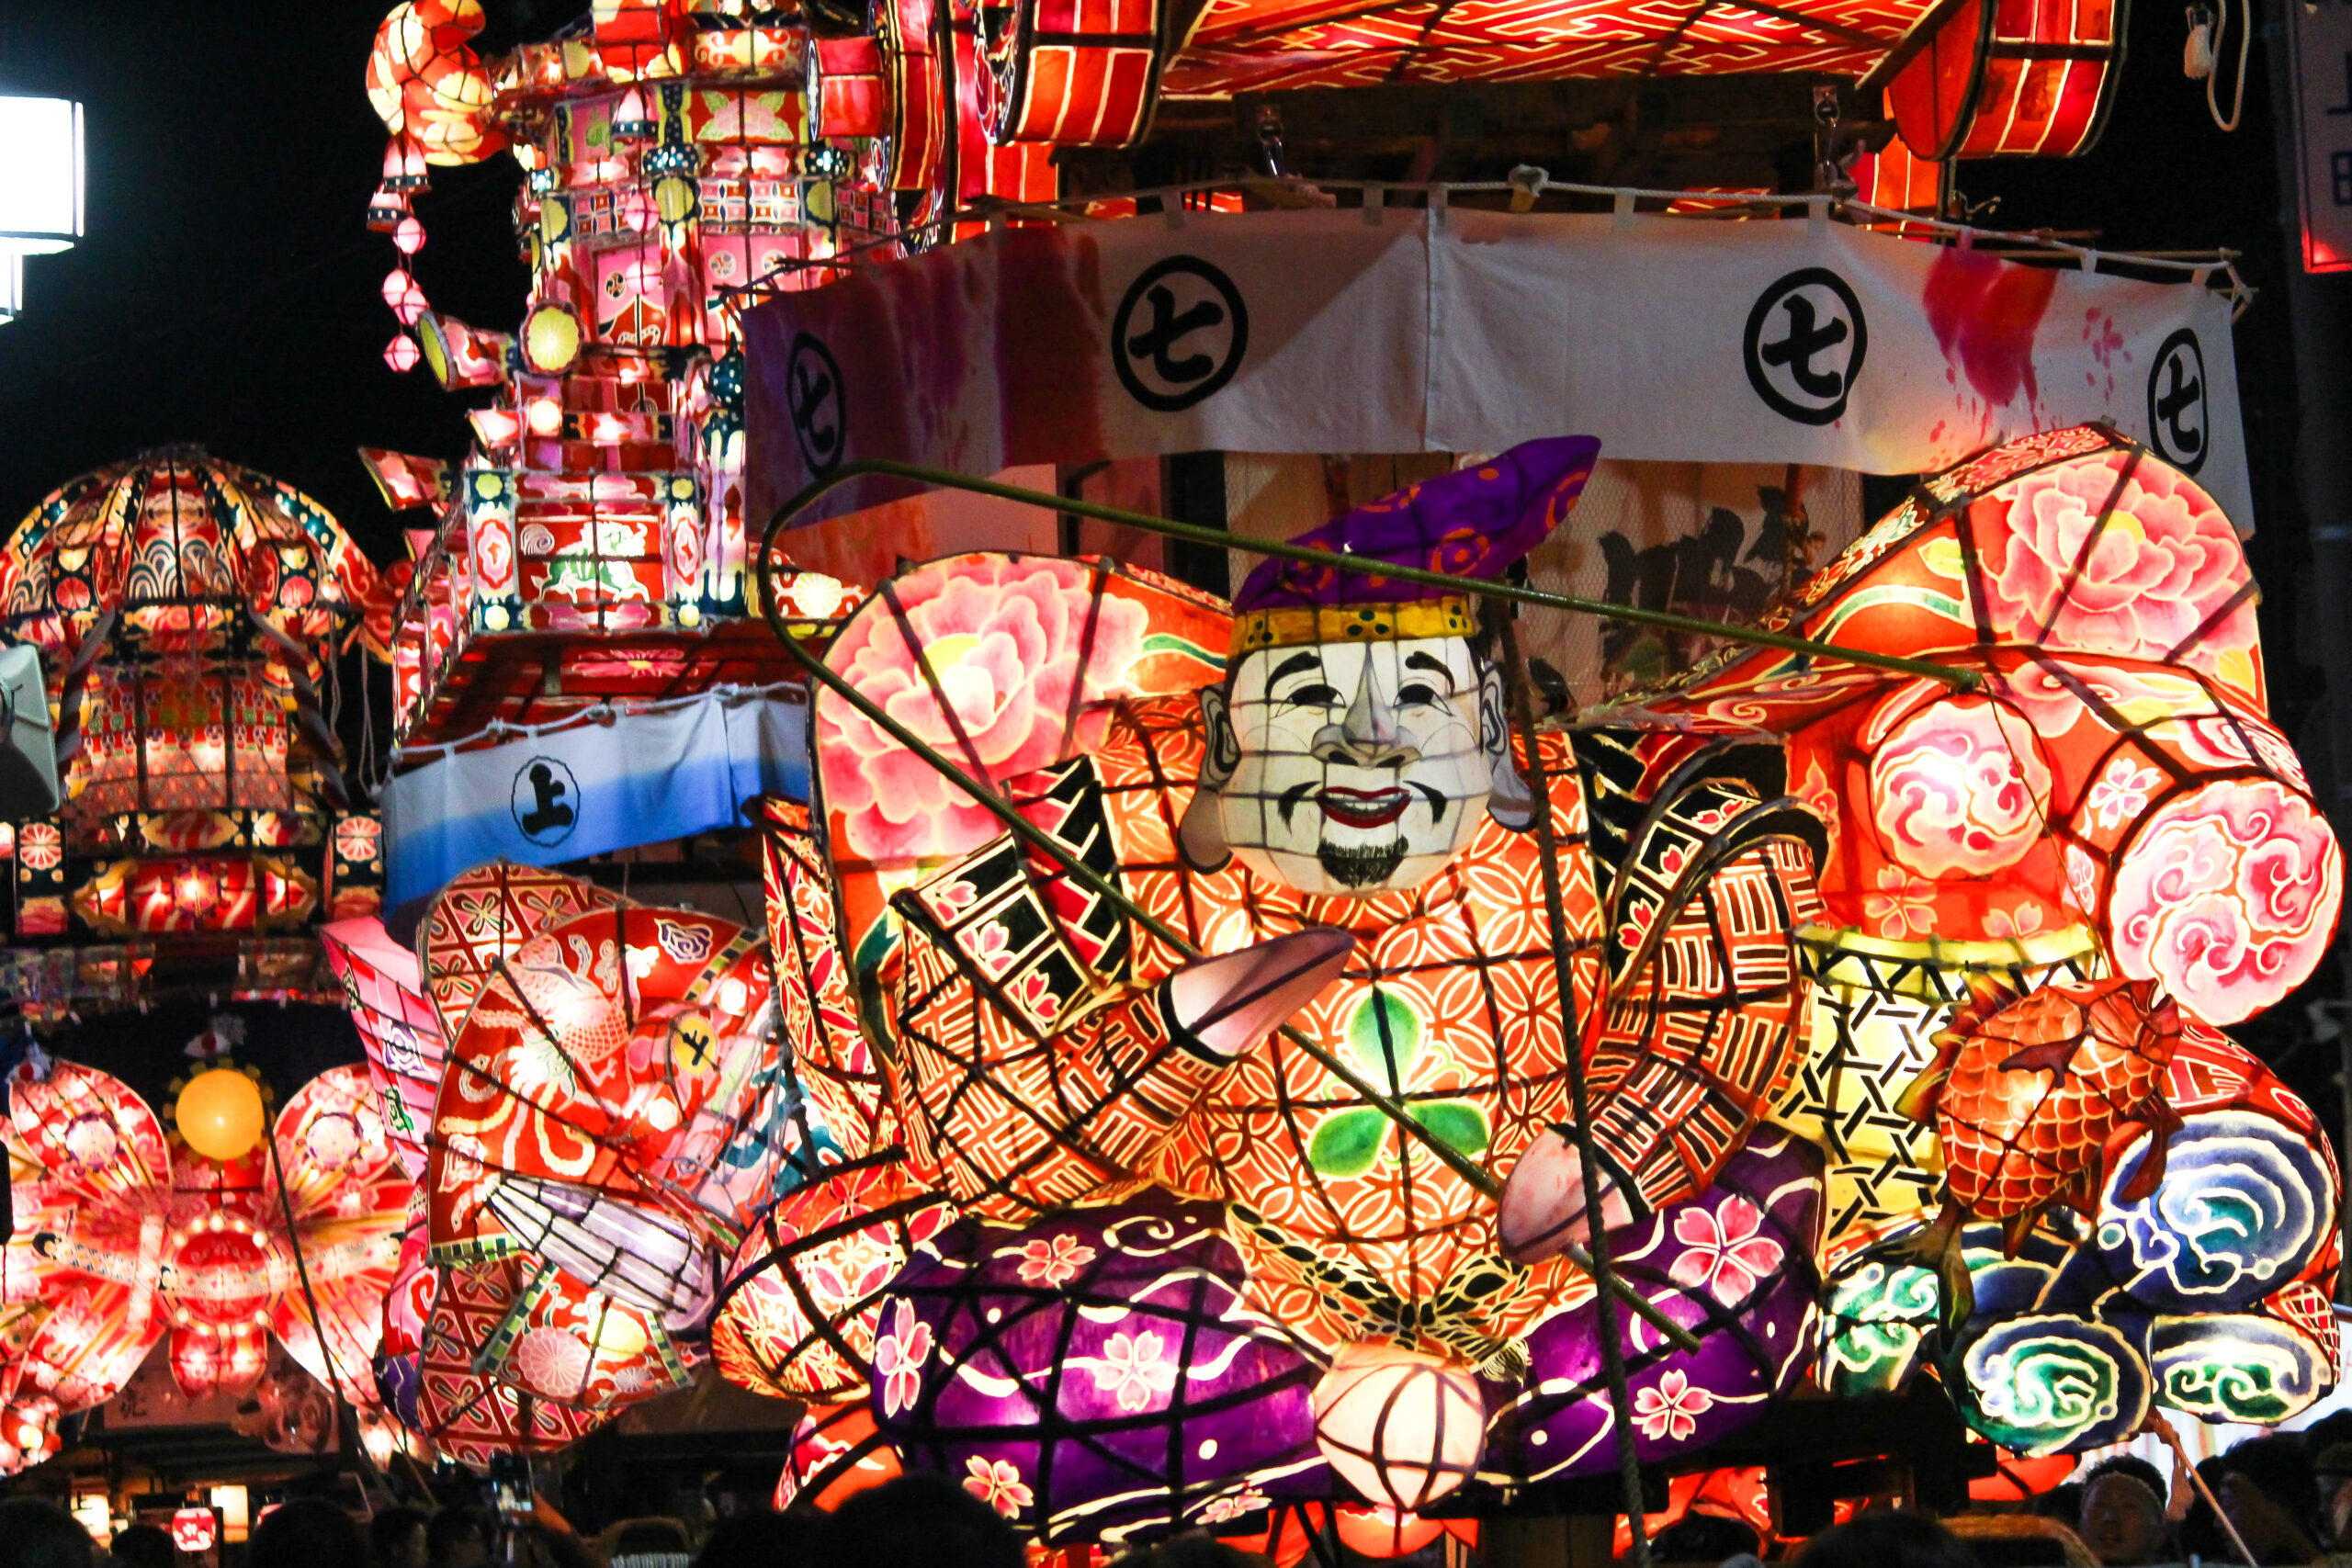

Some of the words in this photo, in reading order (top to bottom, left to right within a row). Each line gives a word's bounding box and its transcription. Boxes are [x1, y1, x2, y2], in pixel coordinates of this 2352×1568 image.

[1128, 285, 1224, 382] 七
[1761, 294, 1848, 398] 七
[522, 763, 573, 836] 上
